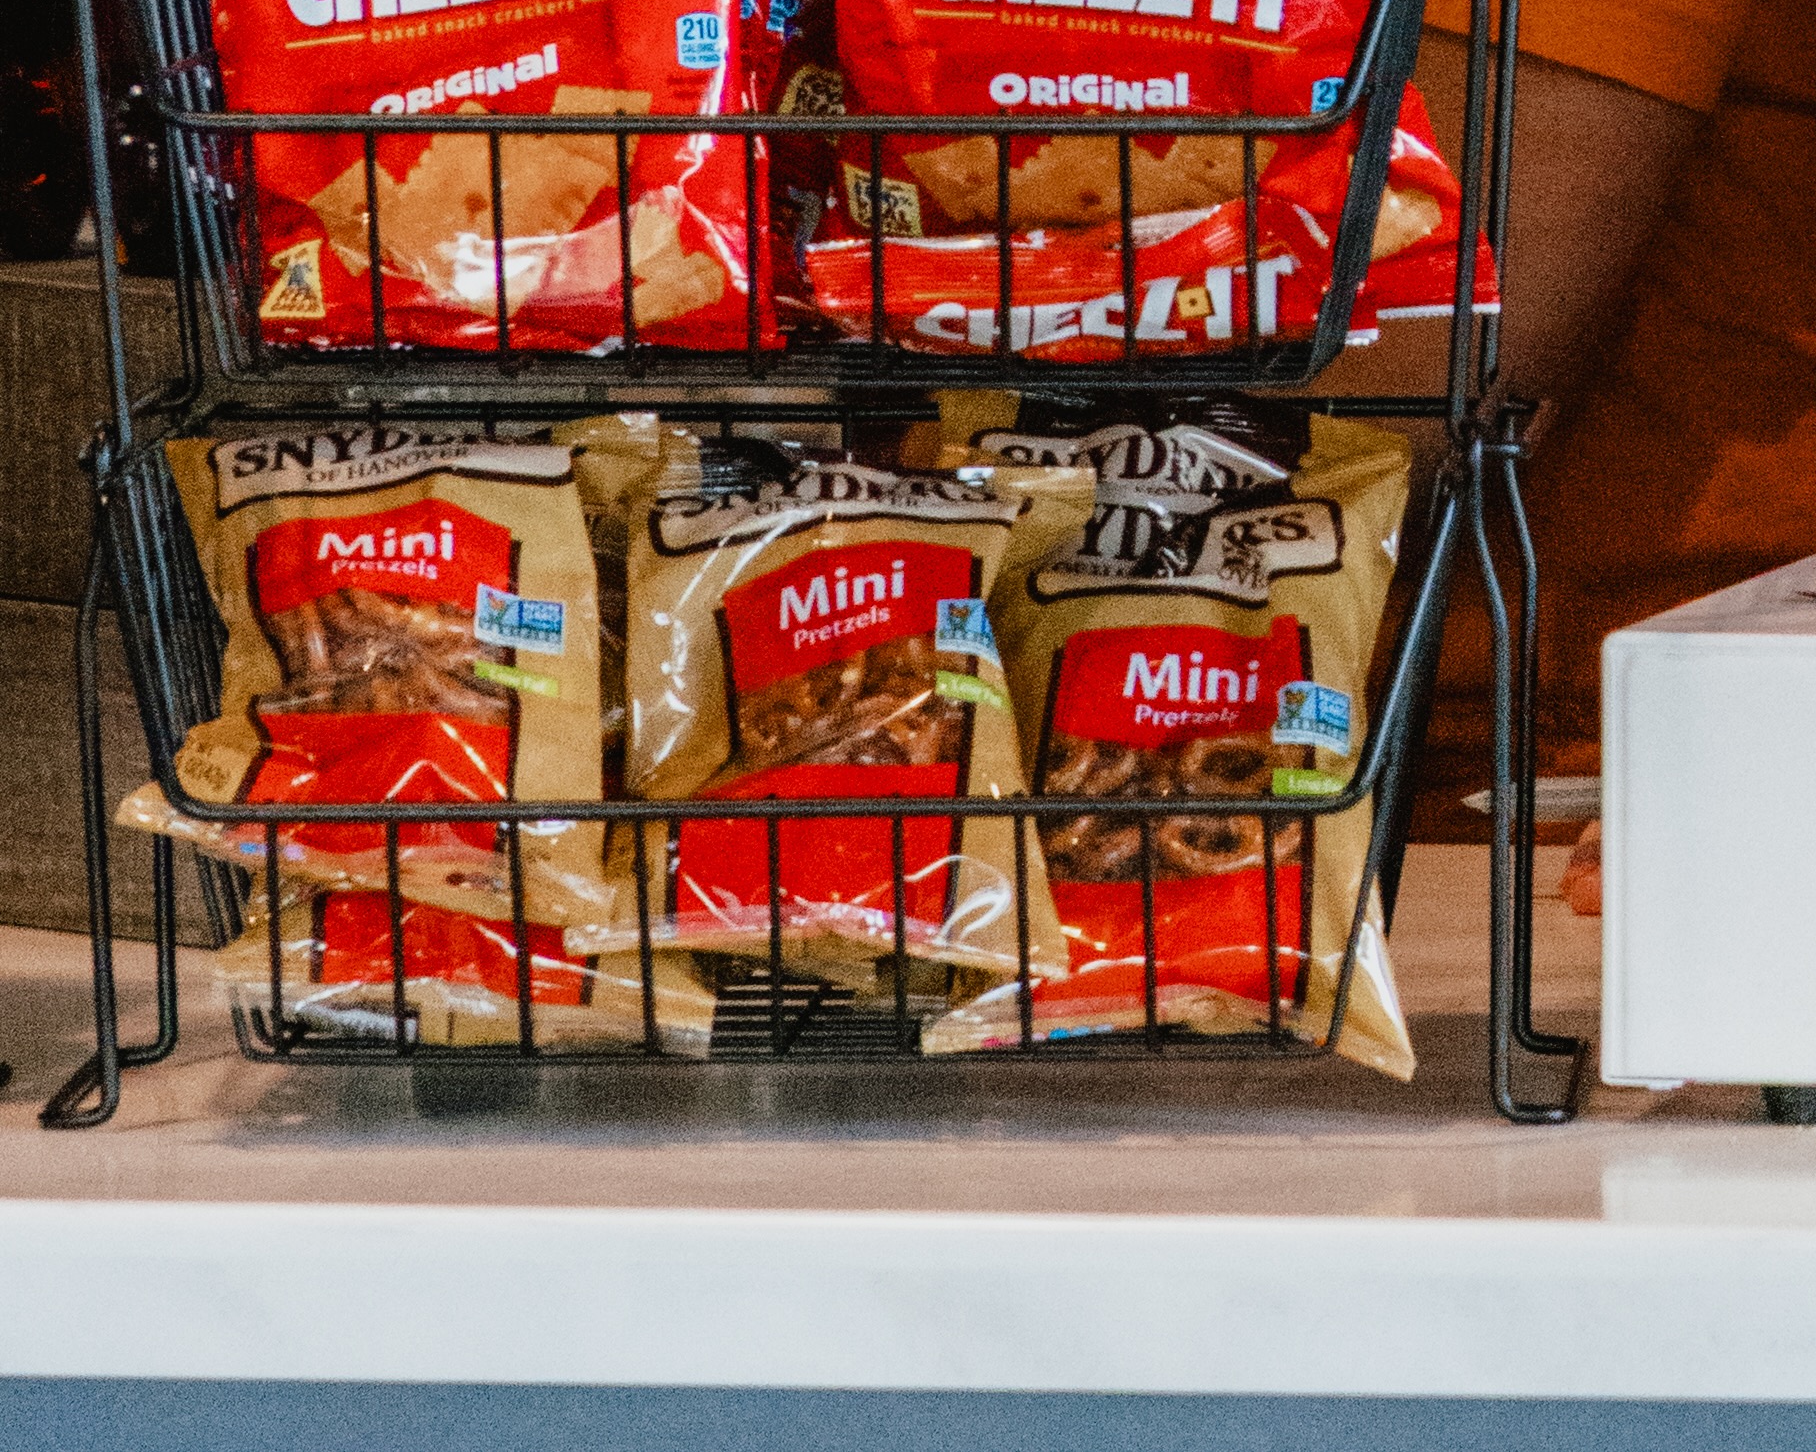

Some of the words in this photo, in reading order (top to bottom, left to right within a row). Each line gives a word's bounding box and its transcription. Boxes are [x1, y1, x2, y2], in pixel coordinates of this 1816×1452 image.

[681, 18, 719, 41] 210
[316, 519, 454, 562] Mini
[331, 560, 438, 580] Pretzels
[779, 560, 905, 630] Mini
[794, 605, 891, 650] Pretzels
[1123, 651, 1259, 703] Mini
